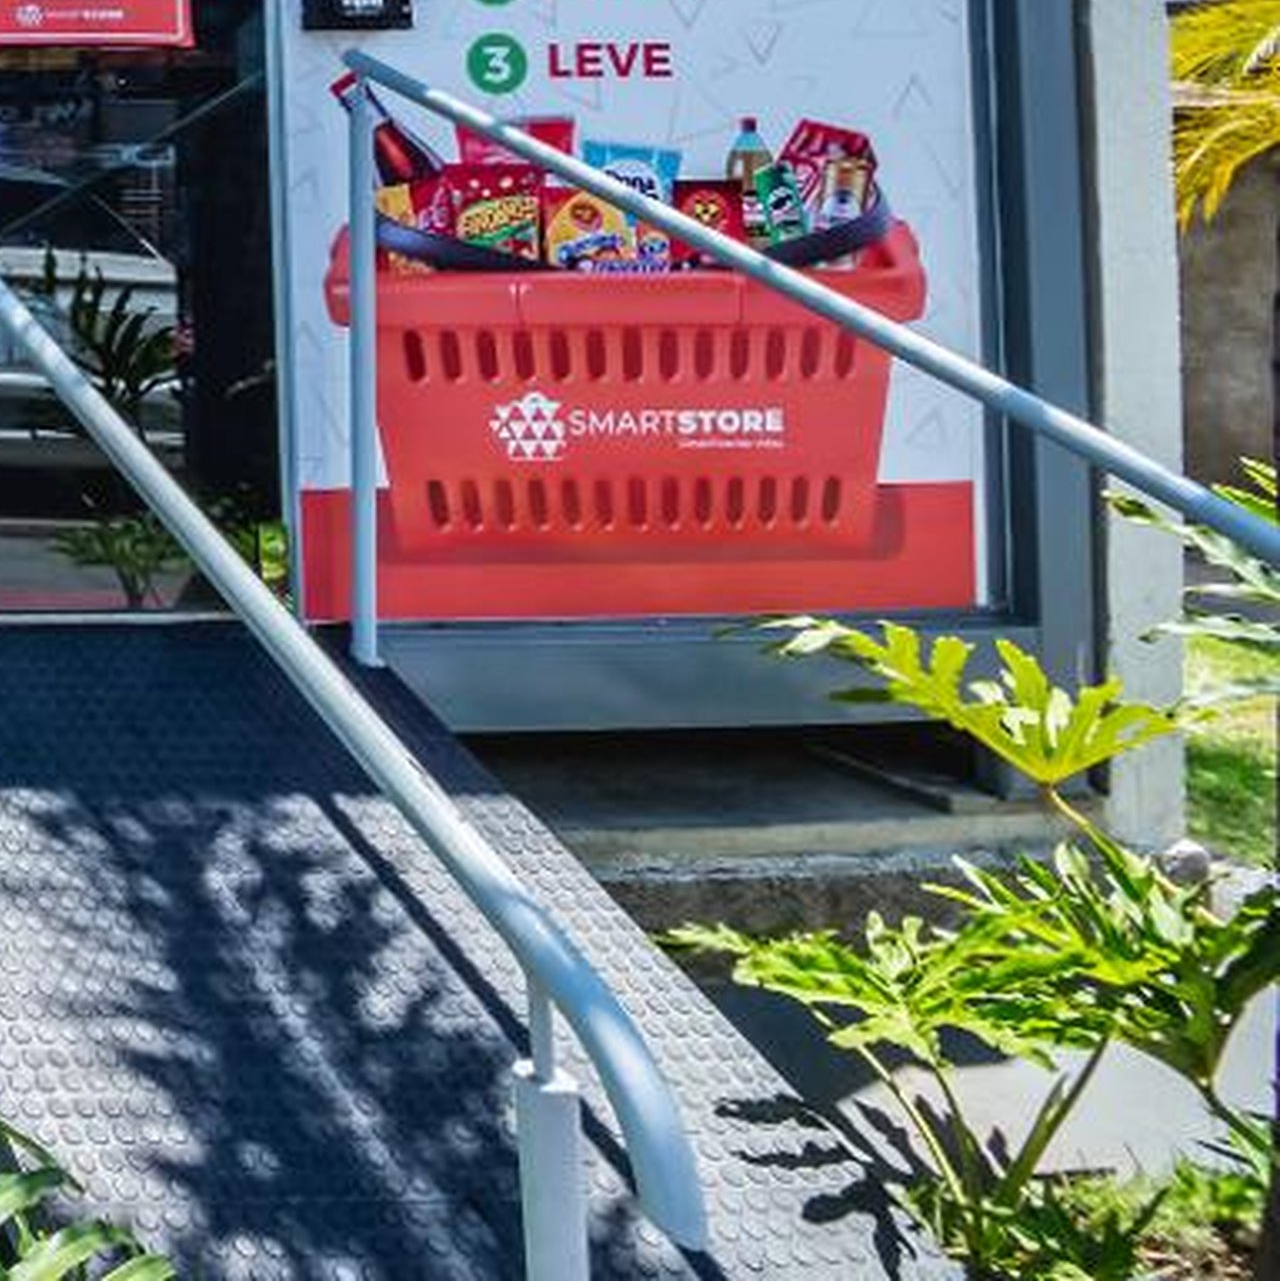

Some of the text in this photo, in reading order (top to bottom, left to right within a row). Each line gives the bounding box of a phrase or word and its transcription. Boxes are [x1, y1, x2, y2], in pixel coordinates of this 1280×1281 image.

[483, 43, 673, 82] 3 LEVE
[568, 408, 784, 436] SMARTSTORE
